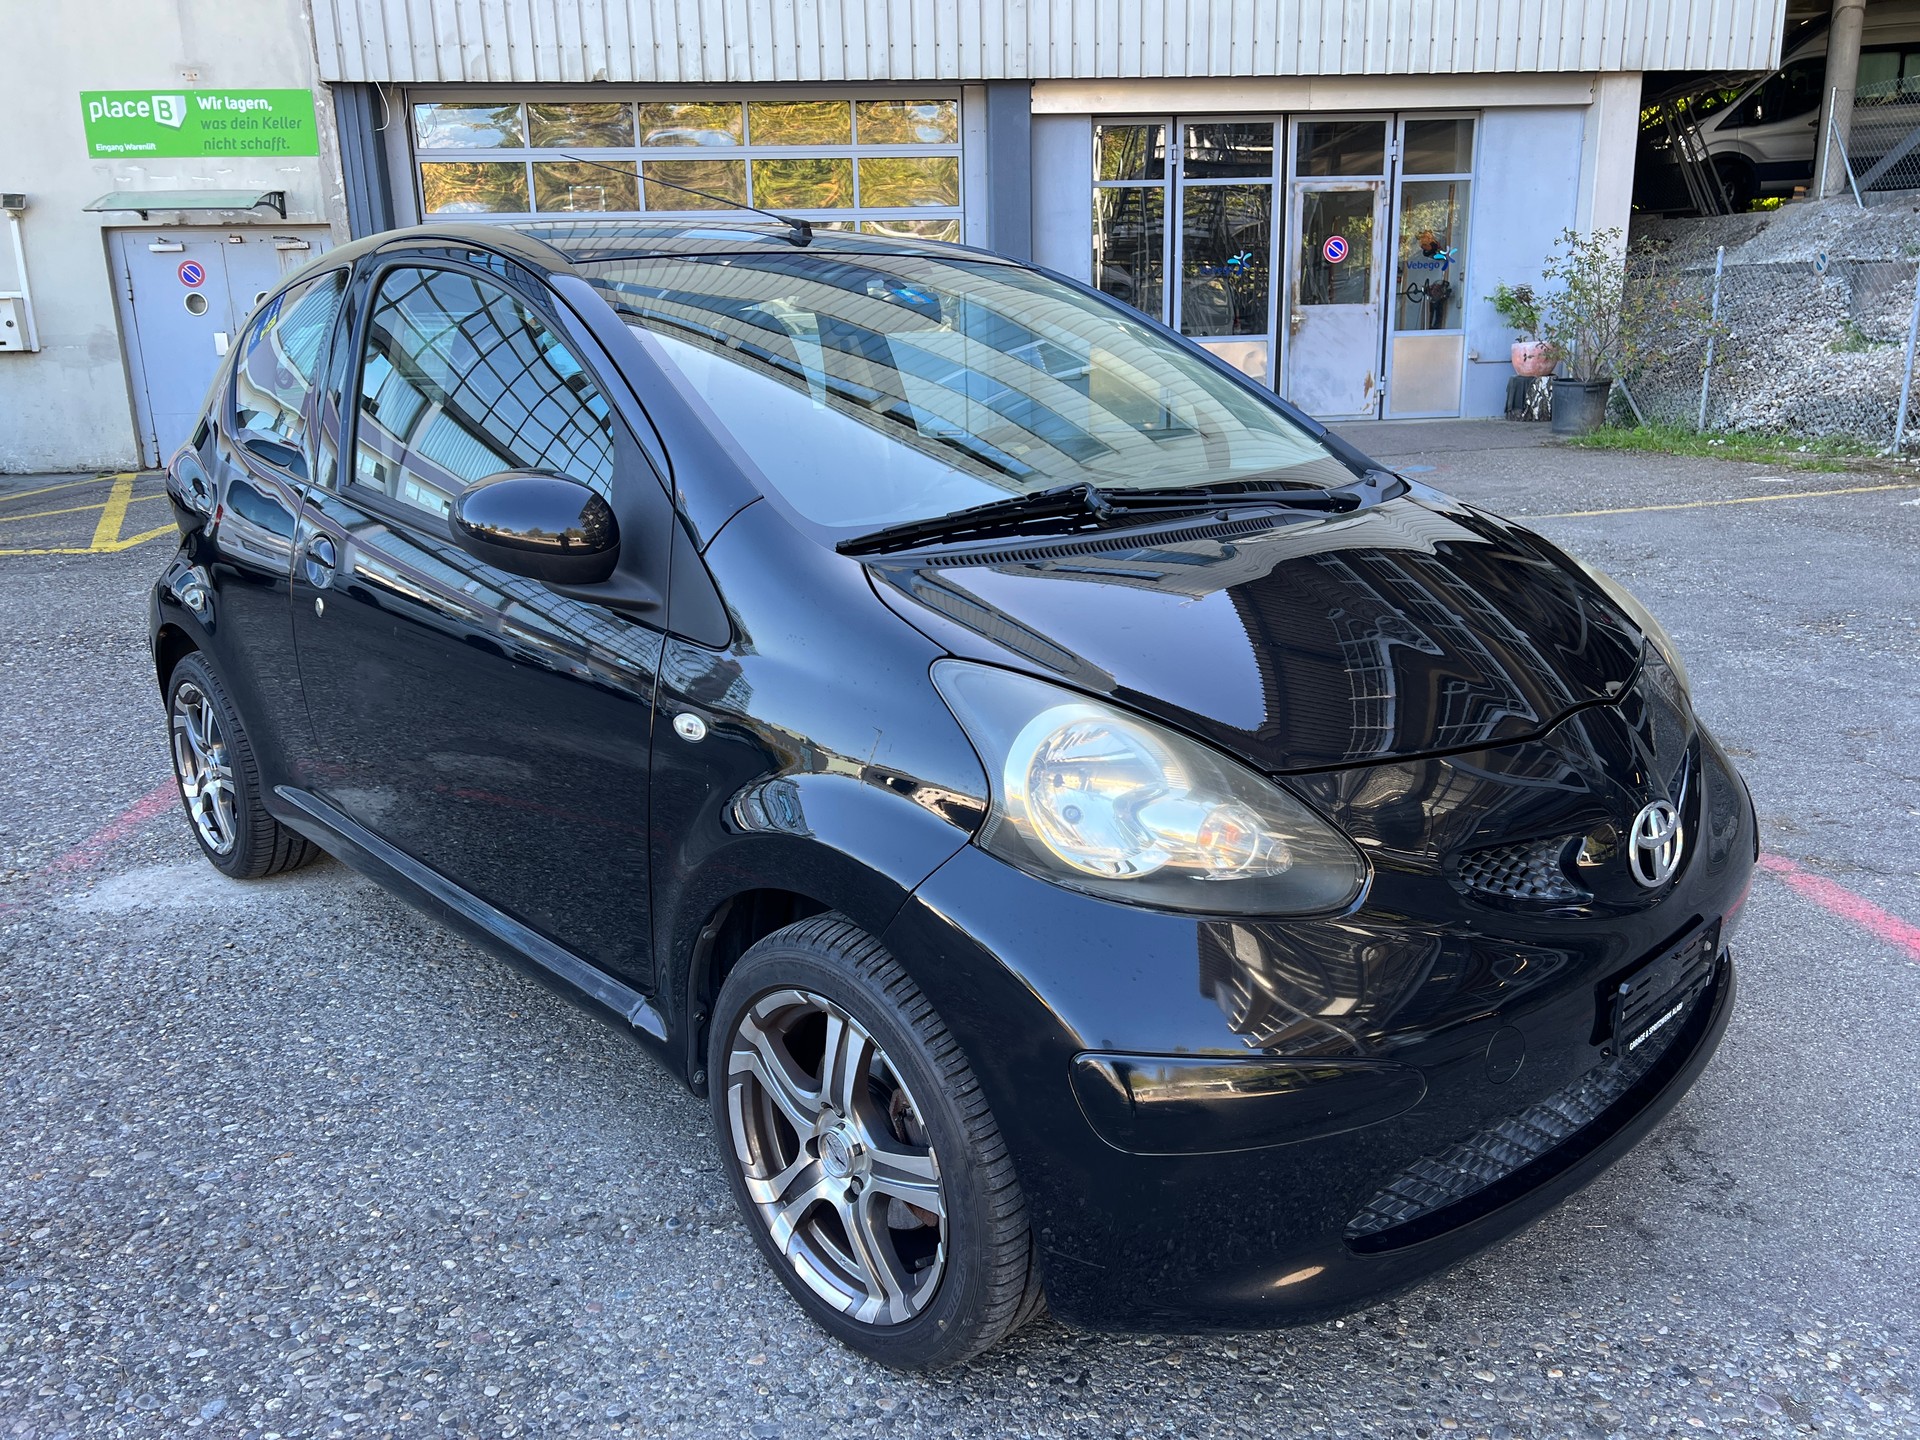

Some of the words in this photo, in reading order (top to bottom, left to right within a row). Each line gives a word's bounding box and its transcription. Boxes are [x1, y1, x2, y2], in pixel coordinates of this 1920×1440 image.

[89, 96, 150, 123] place
[196, 96, 222, 110] Wir
[224, 96, 273, 113] lagern,
[200, 120, 227, 130] was
[230, 117, 258, 130] dein
[262, 116, 302, 130] Keller
[95, 143, 124, 153] Eingang
[203, 137, 237, 150] nicht
[240, 136, 290, 152] schafft.
[1407, 260, 1440, 271] Vebego
